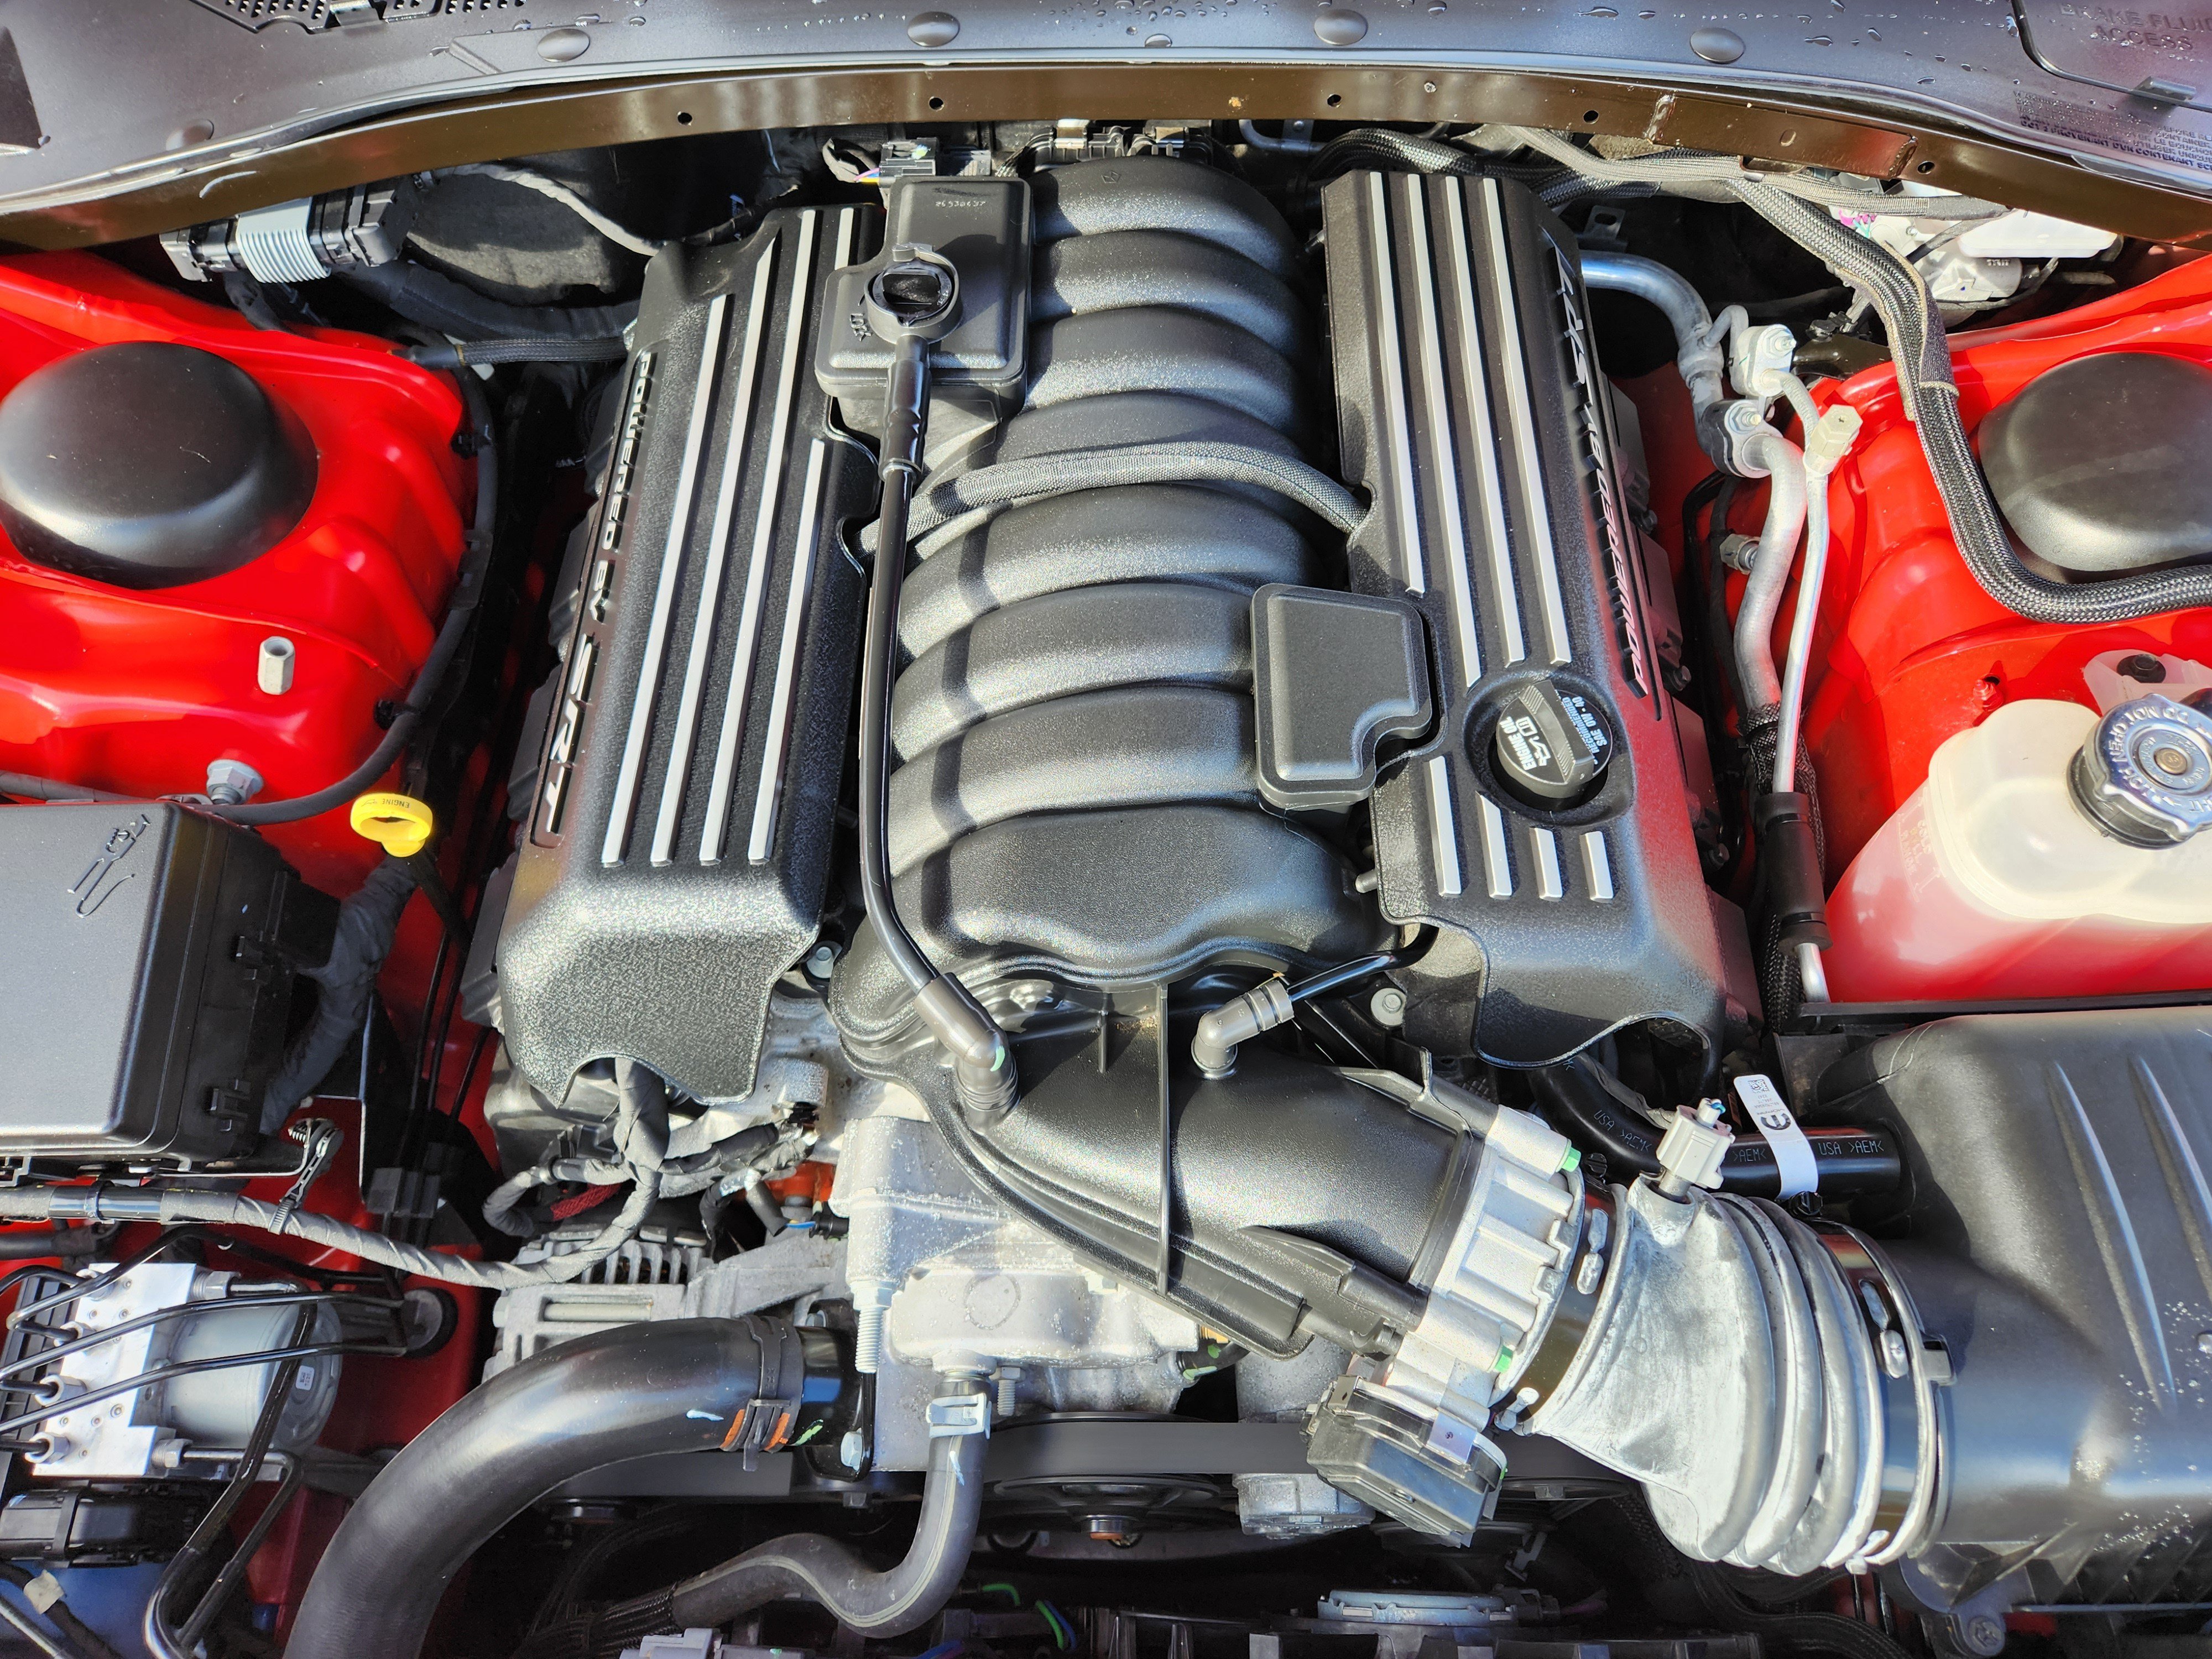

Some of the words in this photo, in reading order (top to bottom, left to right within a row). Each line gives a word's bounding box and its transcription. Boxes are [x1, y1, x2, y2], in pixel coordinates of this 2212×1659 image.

[2058, 3, 2143, 27] BRAKE
[2093, 26, 2193, 50] ACCESS
[2050, 128, 2109, 147] PROVENANT
[2136, 148, 2195, 166] CONTENANT
[2168, 140, 2212, 155] BOUCHO
[1583, 404, 1605, 471] BY
[602, 352, 651, 550] POWERED
[589, 560, 608, 621] BY
[1596, 468, 1648, 695] POWERED
[1499, 716, 1518, 734] OIL
[1562, 697, 1600, 754] RECOMMENDED
[2124, 706, 2160, 726] NOT
[2163, 707, 2189, 725] DO
[546, 633, 592, 833] SRT
[1590, 728, 1608, 747] SAE
[2109, 722, 2128, 763] OPEN
[1507, 732, 1537, 771] ENGINE
[382, 799, 410, 808] ENGINE
[1593, 1109, 1615, 1131] USA
[1818, 1141, 1841, 1155] USA
[1848, 1140, 1884, 1154] >AEM<
